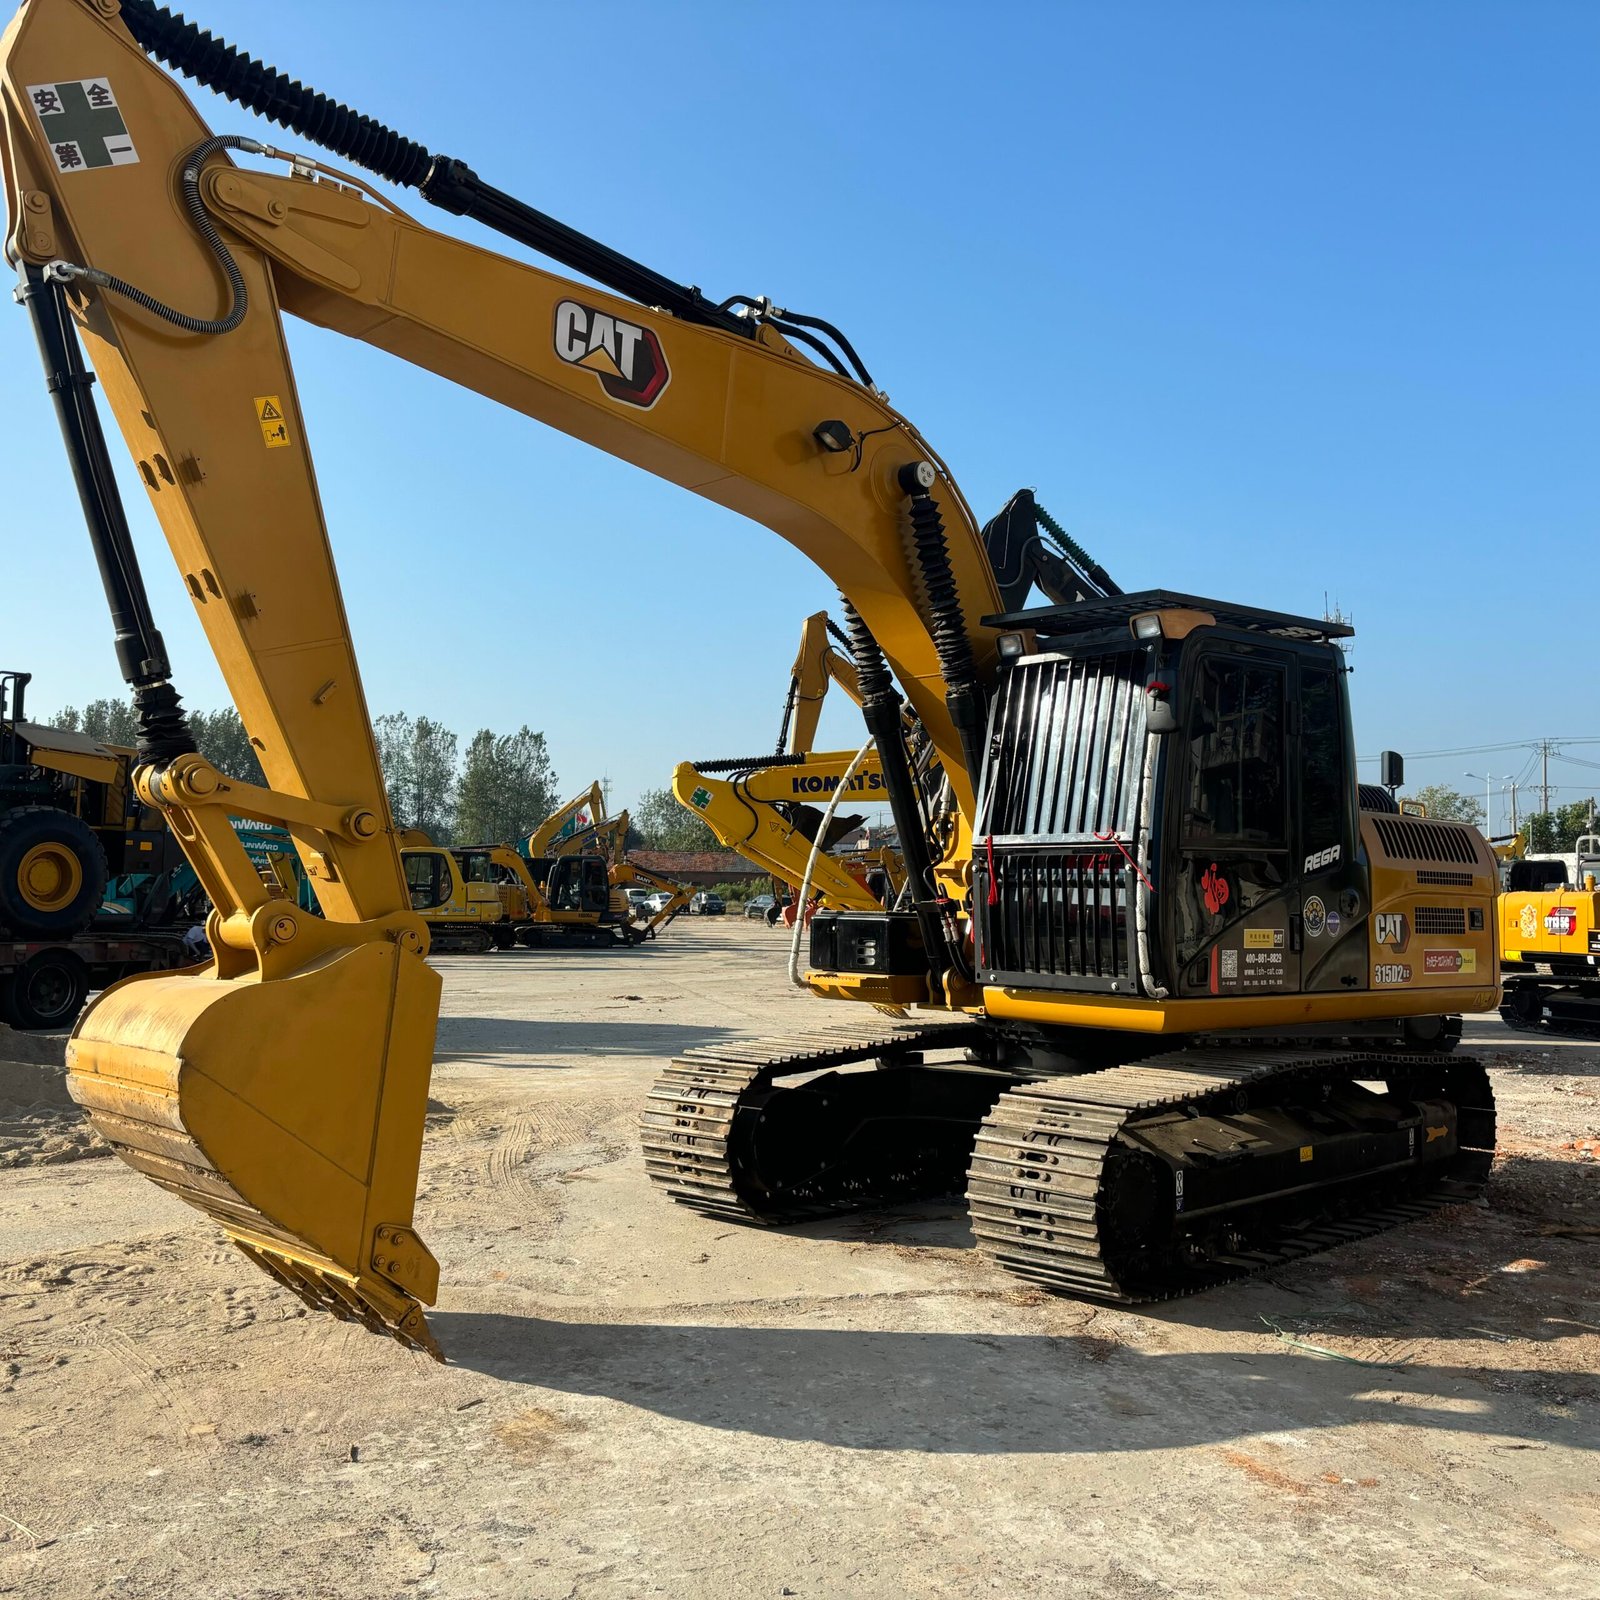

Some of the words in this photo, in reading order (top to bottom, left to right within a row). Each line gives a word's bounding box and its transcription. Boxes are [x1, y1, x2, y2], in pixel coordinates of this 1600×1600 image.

[33, 83, 113, 114] 安全
[55, 143, 132, 169] 第一
[555, 301, 643, 382] CAT
[1304, 844, 1341, 874] REGA
[1274, 934, 1283, 944] CAT
[1375, 914, 1402, 944] CAT
[1375, 964, 1403, 983] 315D2
